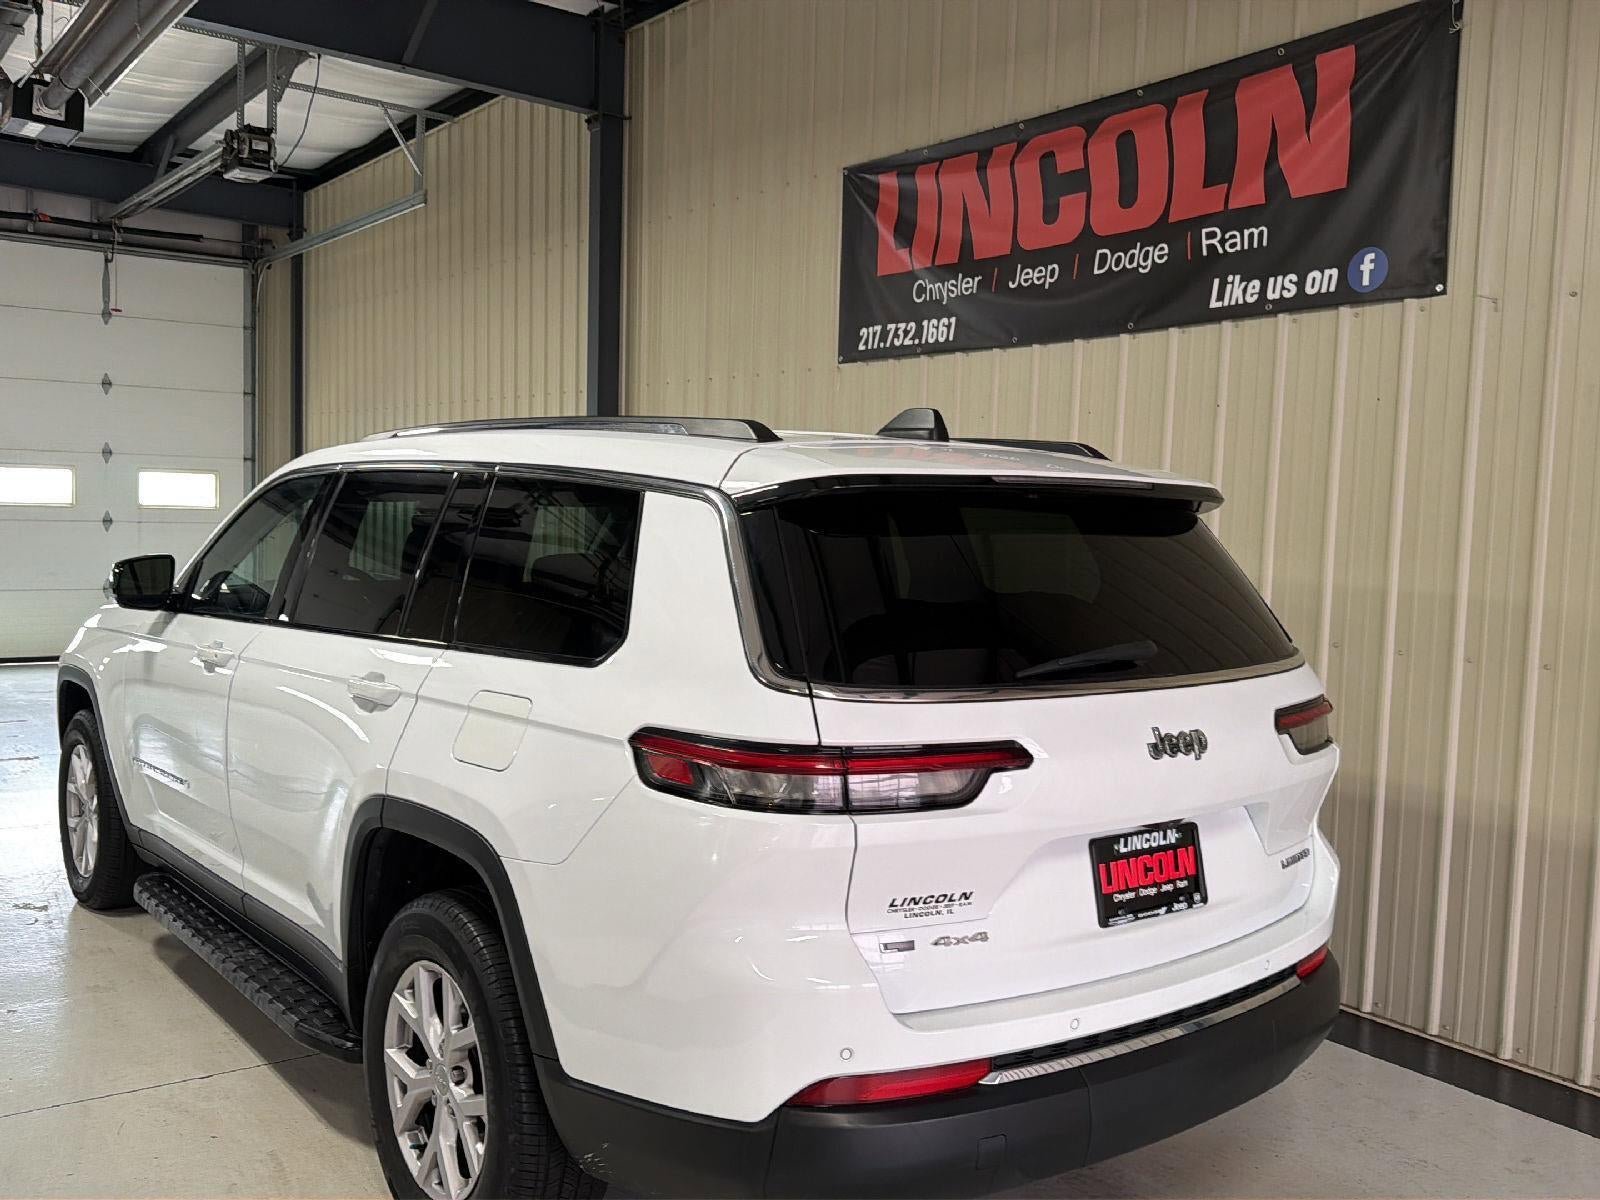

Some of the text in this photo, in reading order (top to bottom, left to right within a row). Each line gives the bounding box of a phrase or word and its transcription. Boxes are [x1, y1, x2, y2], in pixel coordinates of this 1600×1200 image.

[876, 44, 1356, 277] LINCOLN
[912, 226, 1268, 304] Chrysler Jeep Dodge Ram
[1208, 274, 1260, 309] Like
[1266, 273, 1298, 300] us
[1304, 267, 1339, 295] on
[858, 316, 957, 351] 217.732.1661
[1147, 726, 1208, 760] Jeep
[1119, 828, 1177, 853] LINCOLN
[1099, 845, 1197, 895] LINCOLN
[888, 891, 974, 908] LINCOLN
[930, 931, 989, 947] 4x4
